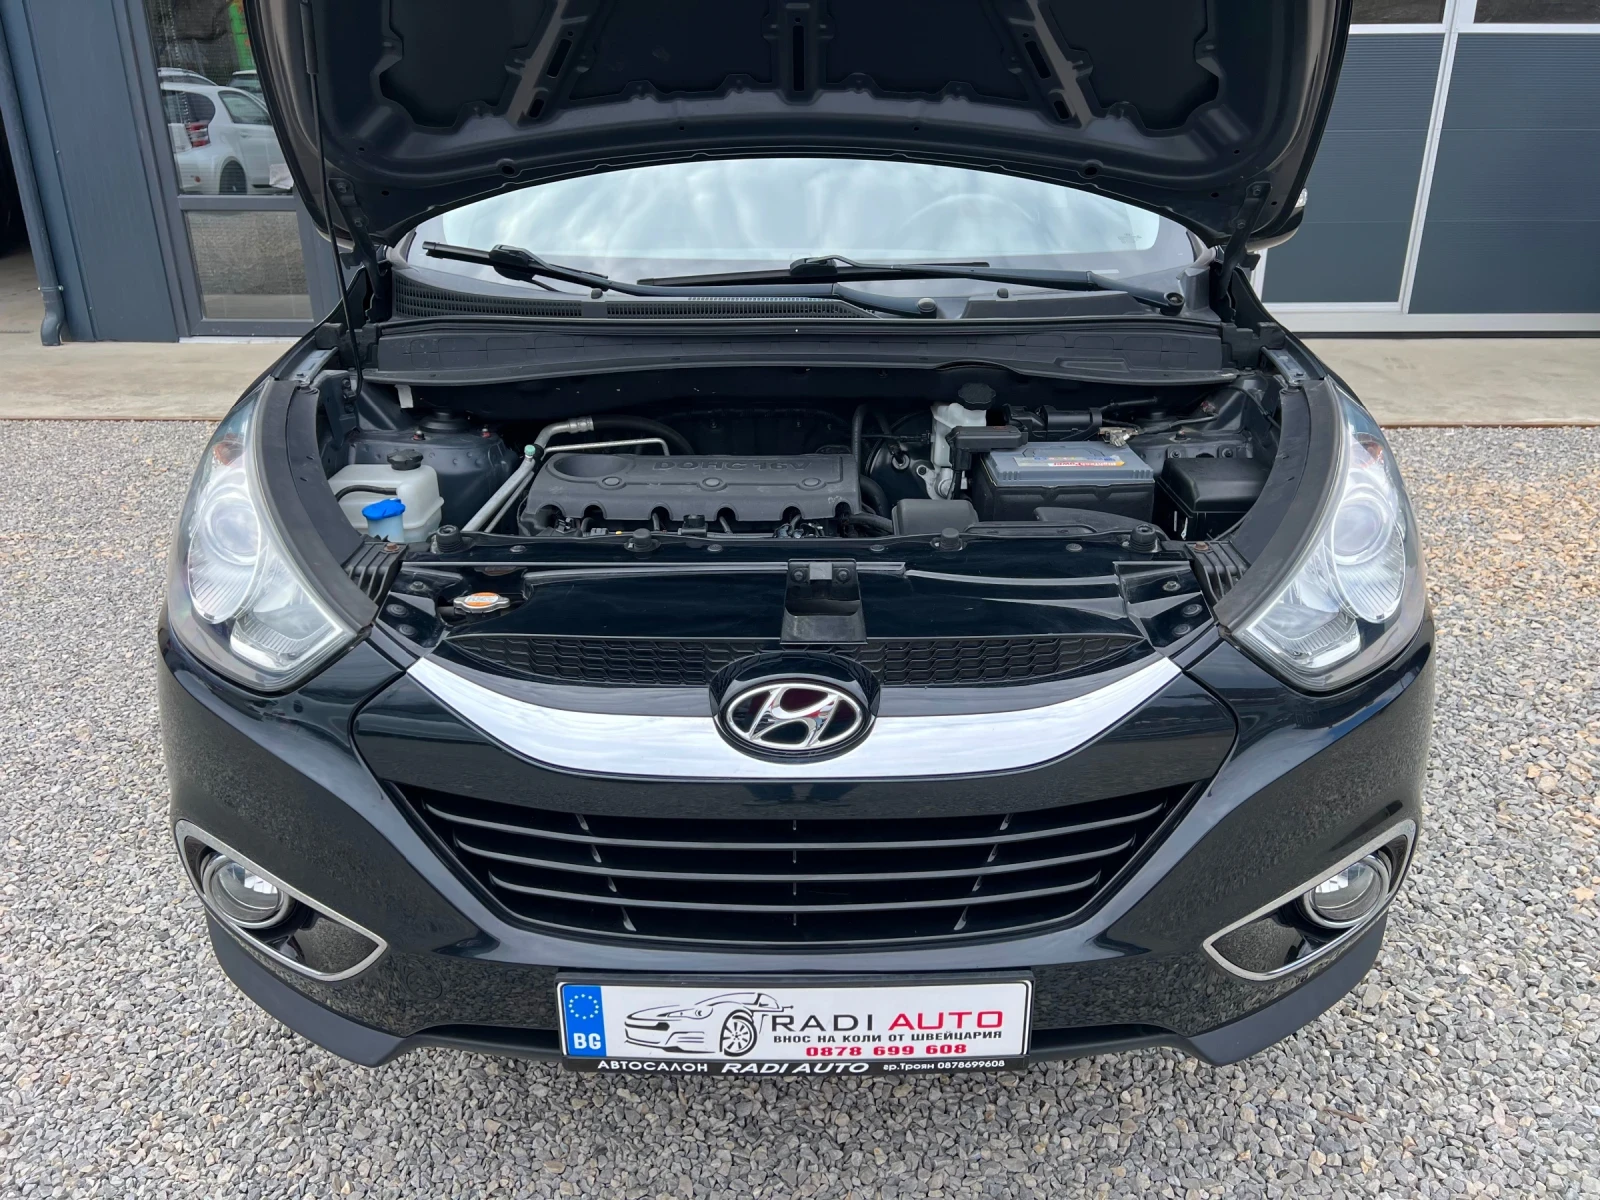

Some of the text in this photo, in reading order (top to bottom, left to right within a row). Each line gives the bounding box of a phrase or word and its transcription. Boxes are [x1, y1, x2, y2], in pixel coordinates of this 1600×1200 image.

[652, 460, 813, 471] DOHC 16V
[771, 1010, 1003, 1032] RADI AUTO
[573, 1033, 601, 1050] BG
[773, 1030, 1003, 1044] ВНОС НА КОЛИ ОТ ШВЕЙЦАРИЯ
[805, 1044, 967, 1057] 0878 699 608
[597, 1060, 709, 1073] АВТОСАЛОН
[721, 1063, 789, 1074] RADI
[791, 1062, 870, 1074] AUTO
[937, 1060, 1006, 1070] 0878699608
